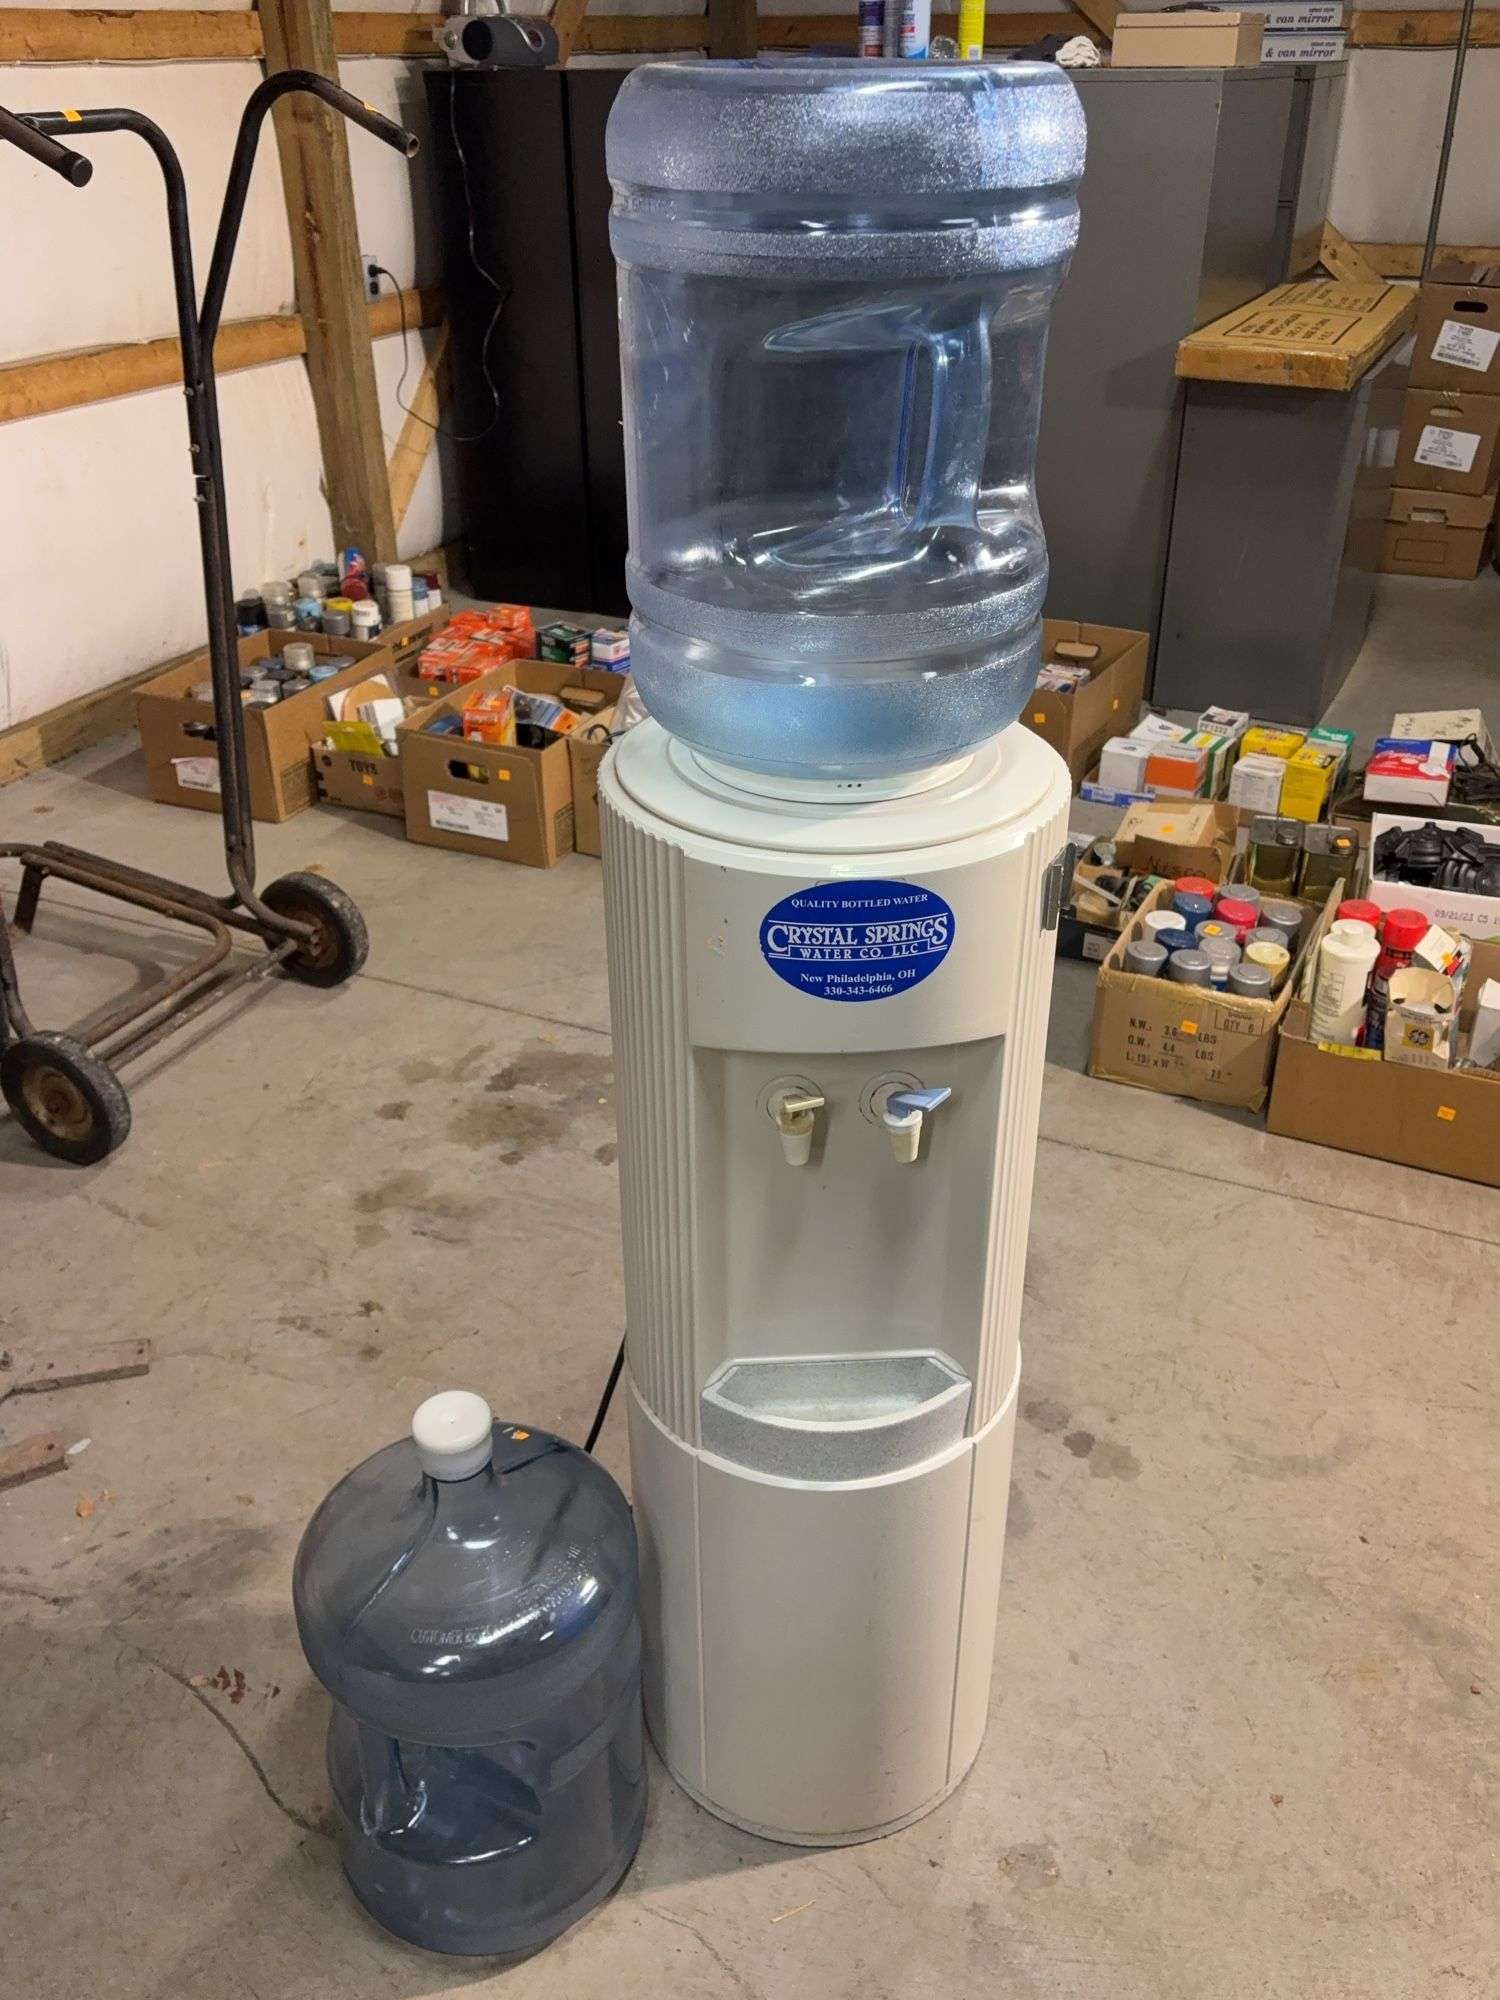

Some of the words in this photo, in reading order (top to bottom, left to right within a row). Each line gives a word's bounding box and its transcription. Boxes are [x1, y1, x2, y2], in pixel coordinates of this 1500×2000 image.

[1276, 14, 1295, 24] van
[1298, 13, 1334, 24] mirror
[1265, 47, 1274, 58] &
[1277, 48, 1296, 58] van
[1299, 47, 1335, 58] mirror
[791, 898, 839, 909] QUALITY
[841, 898, 891, 909] BOTTLED
[893, 894, 928, 905] WATER
[767, 924, 858, 953] CRYSTAL
[864, 916, 948, 946] SPRINGS
[800, 948, 852, 960] WATER
[859, 947, 884, 959] CO.
[892, 943, 919, 957] LLC
[800, 973, 823, 983] New
[827, 971, 895, 984] Philadelphia,
[897, 969, 916, 979] OH
[823, 984, 893, 996] 330-343-6466
